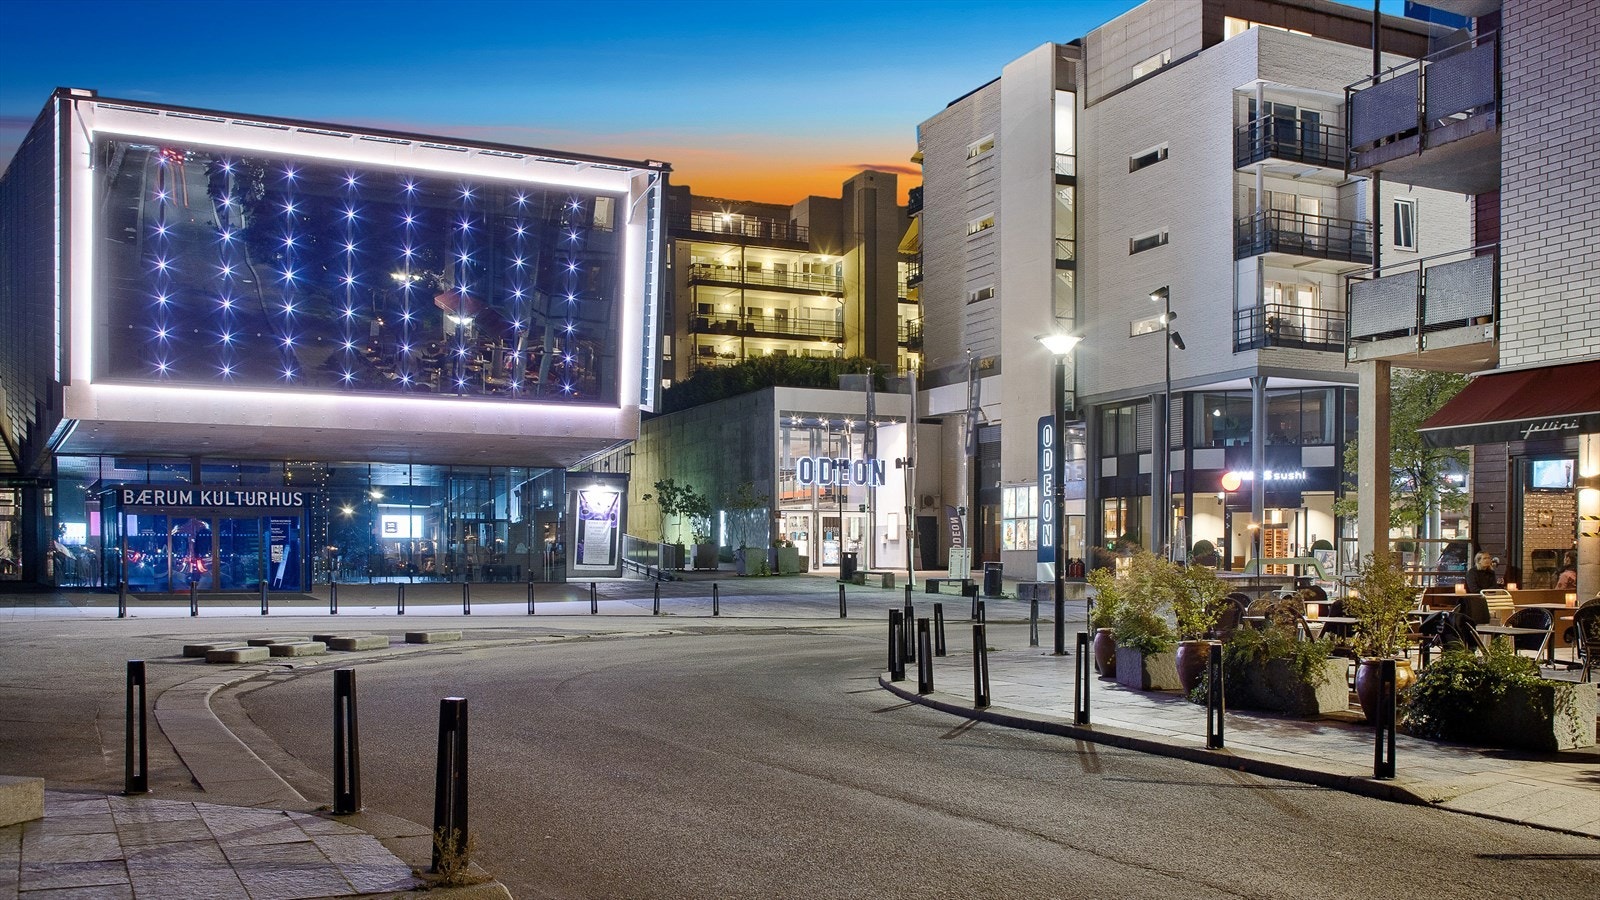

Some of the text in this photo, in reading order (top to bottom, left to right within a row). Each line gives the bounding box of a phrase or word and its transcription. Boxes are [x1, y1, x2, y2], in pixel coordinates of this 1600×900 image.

[1520, 420, 1579, 439] fellini
[796, 456, 886, 486] ODEON
[1273, 471, 1306, 480] sushi
[1042, 424, 1053, 547] ODEON
[123, 489, 304, 507] BÆRUM KULTURHUS
